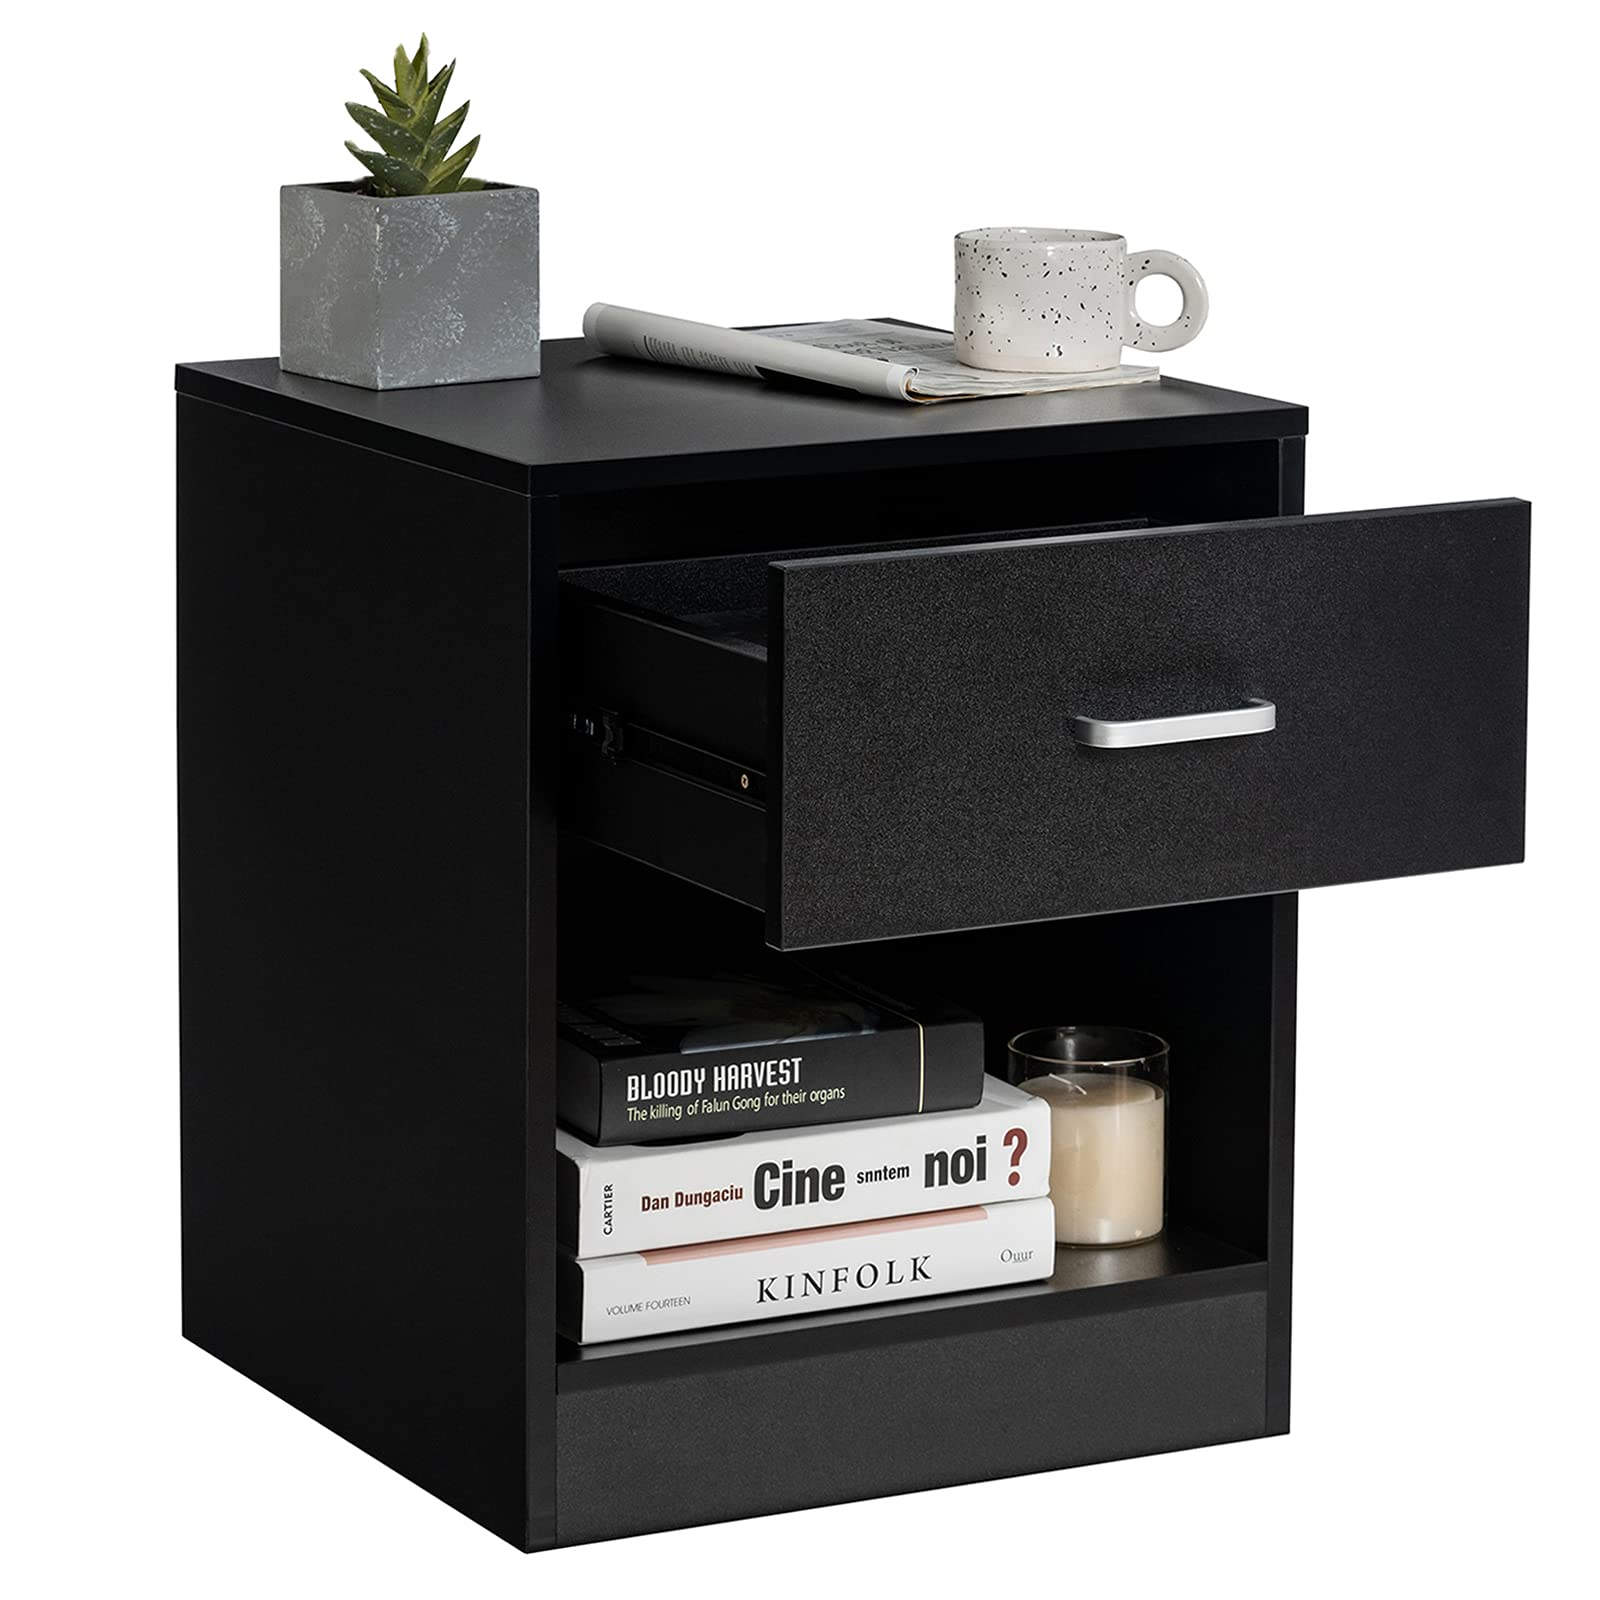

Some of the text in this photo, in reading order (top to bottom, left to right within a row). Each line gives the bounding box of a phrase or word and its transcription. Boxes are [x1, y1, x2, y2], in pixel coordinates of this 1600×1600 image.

[627, 1057, 803, 1102] BLOODY HARVEST
[627, 1086, 846, 1122] The killing of Falun Gong for their organs
[754, 1160, 846, 1211] Cine
[923, 1134, 988, 1189] noi
[1003, 1128, 1028, 1187] ?
[603, 1183, 615, 1236] CARTIER
[641, 1184, 744, 1213] Dan Dungaciu
[756, 1255, 933, 1304] KINFOLK
[606, 1296, 691, 1316] VOLUME FOURTEEN
